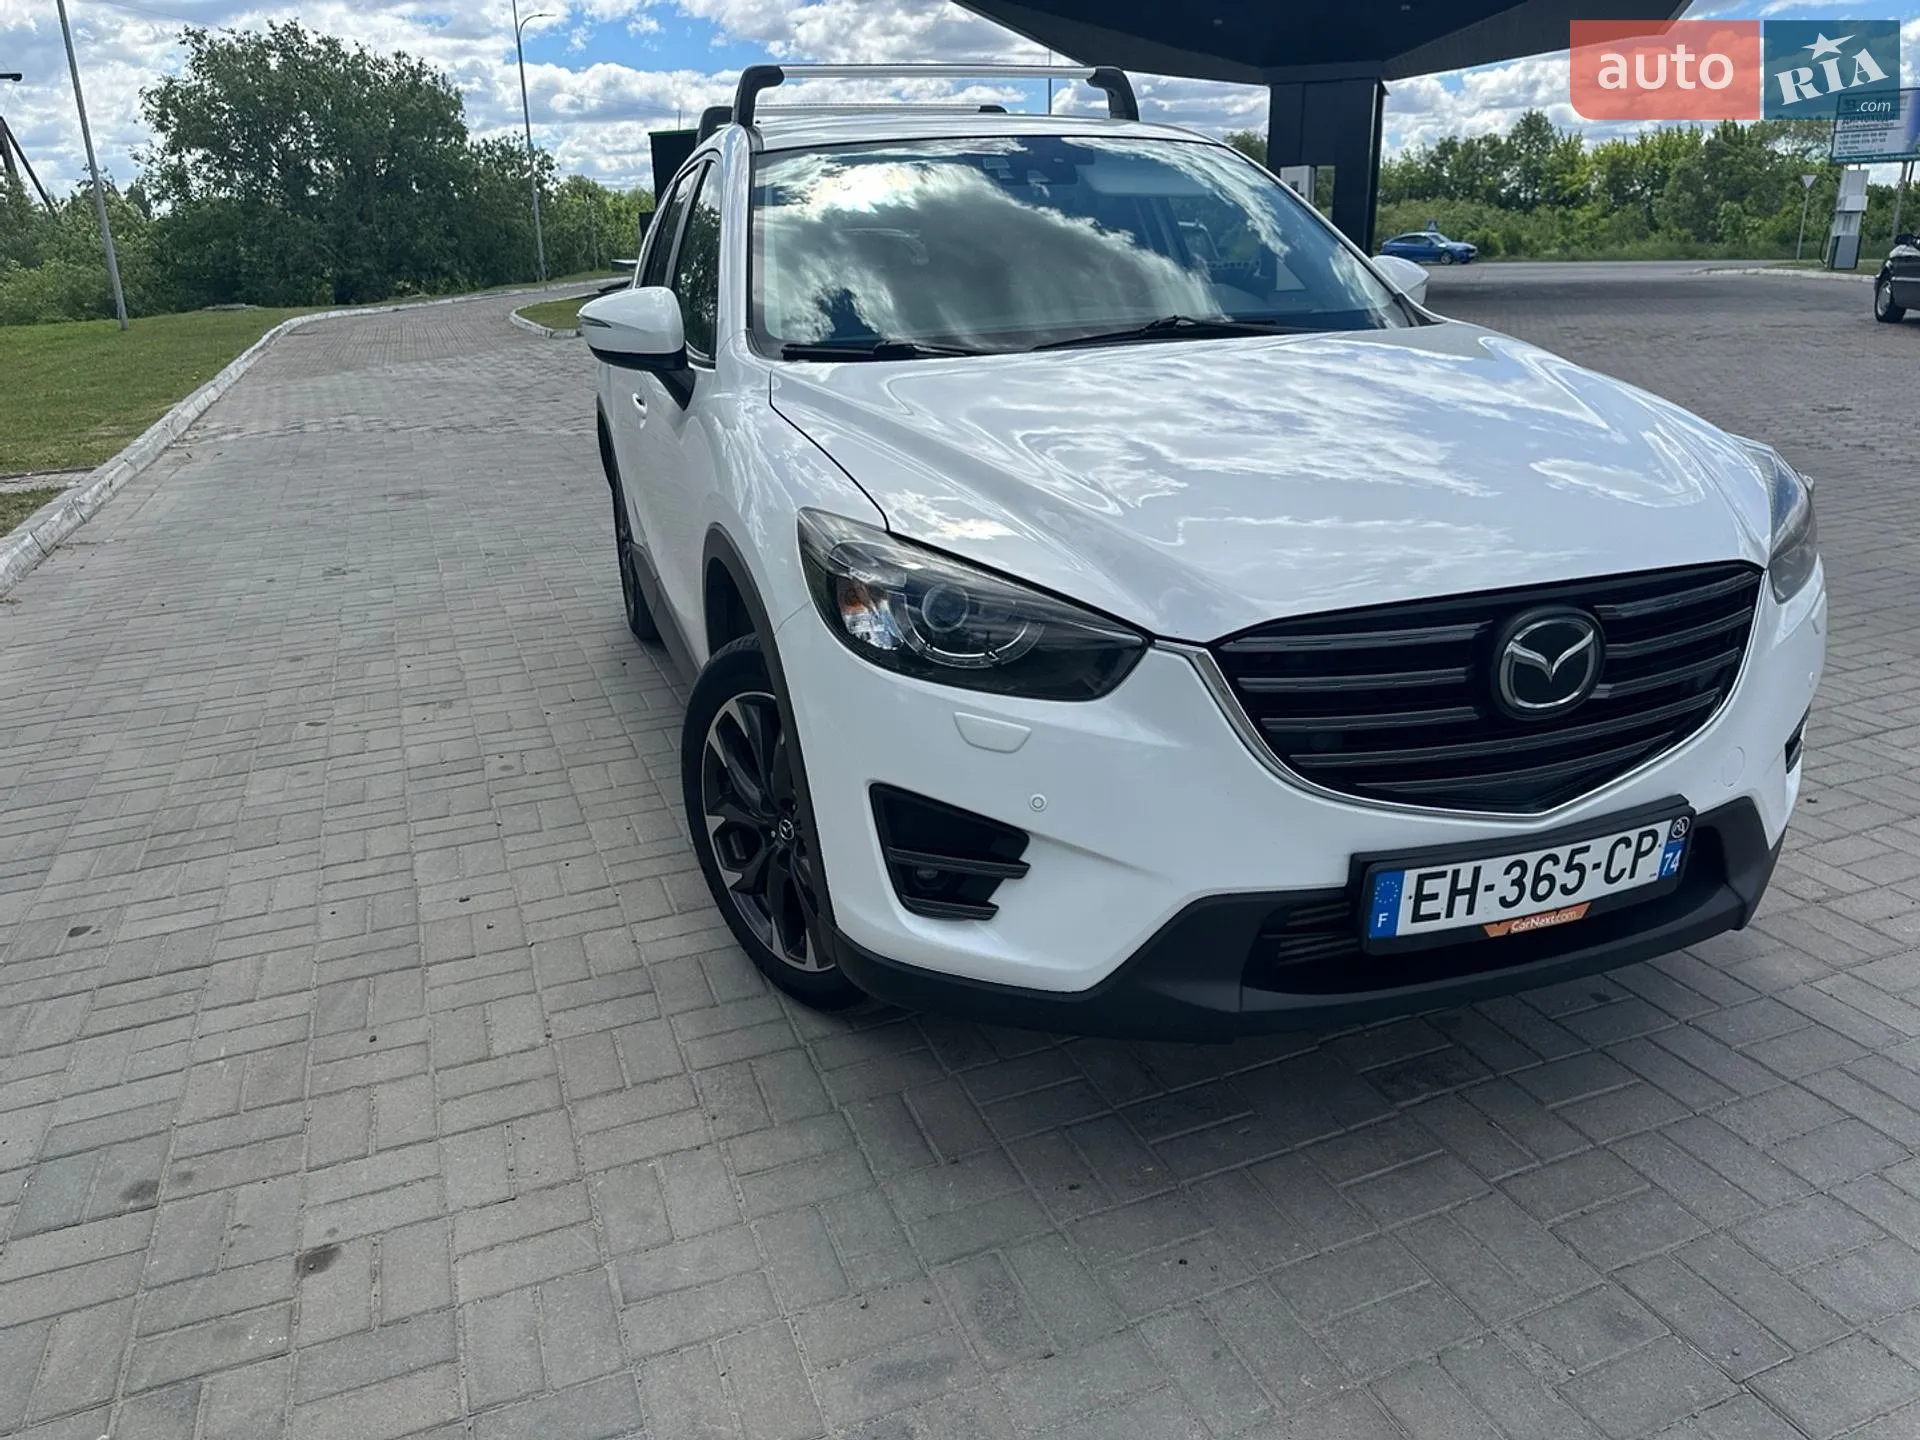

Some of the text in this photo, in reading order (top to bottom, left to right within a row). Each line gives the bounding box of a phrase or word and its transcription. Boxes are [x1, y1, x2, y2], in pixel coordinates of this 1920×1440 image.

[1377, 828, 1683, 929] F EH-365-CP 74
[1511, 910, 1577, 931] CarNext.com
